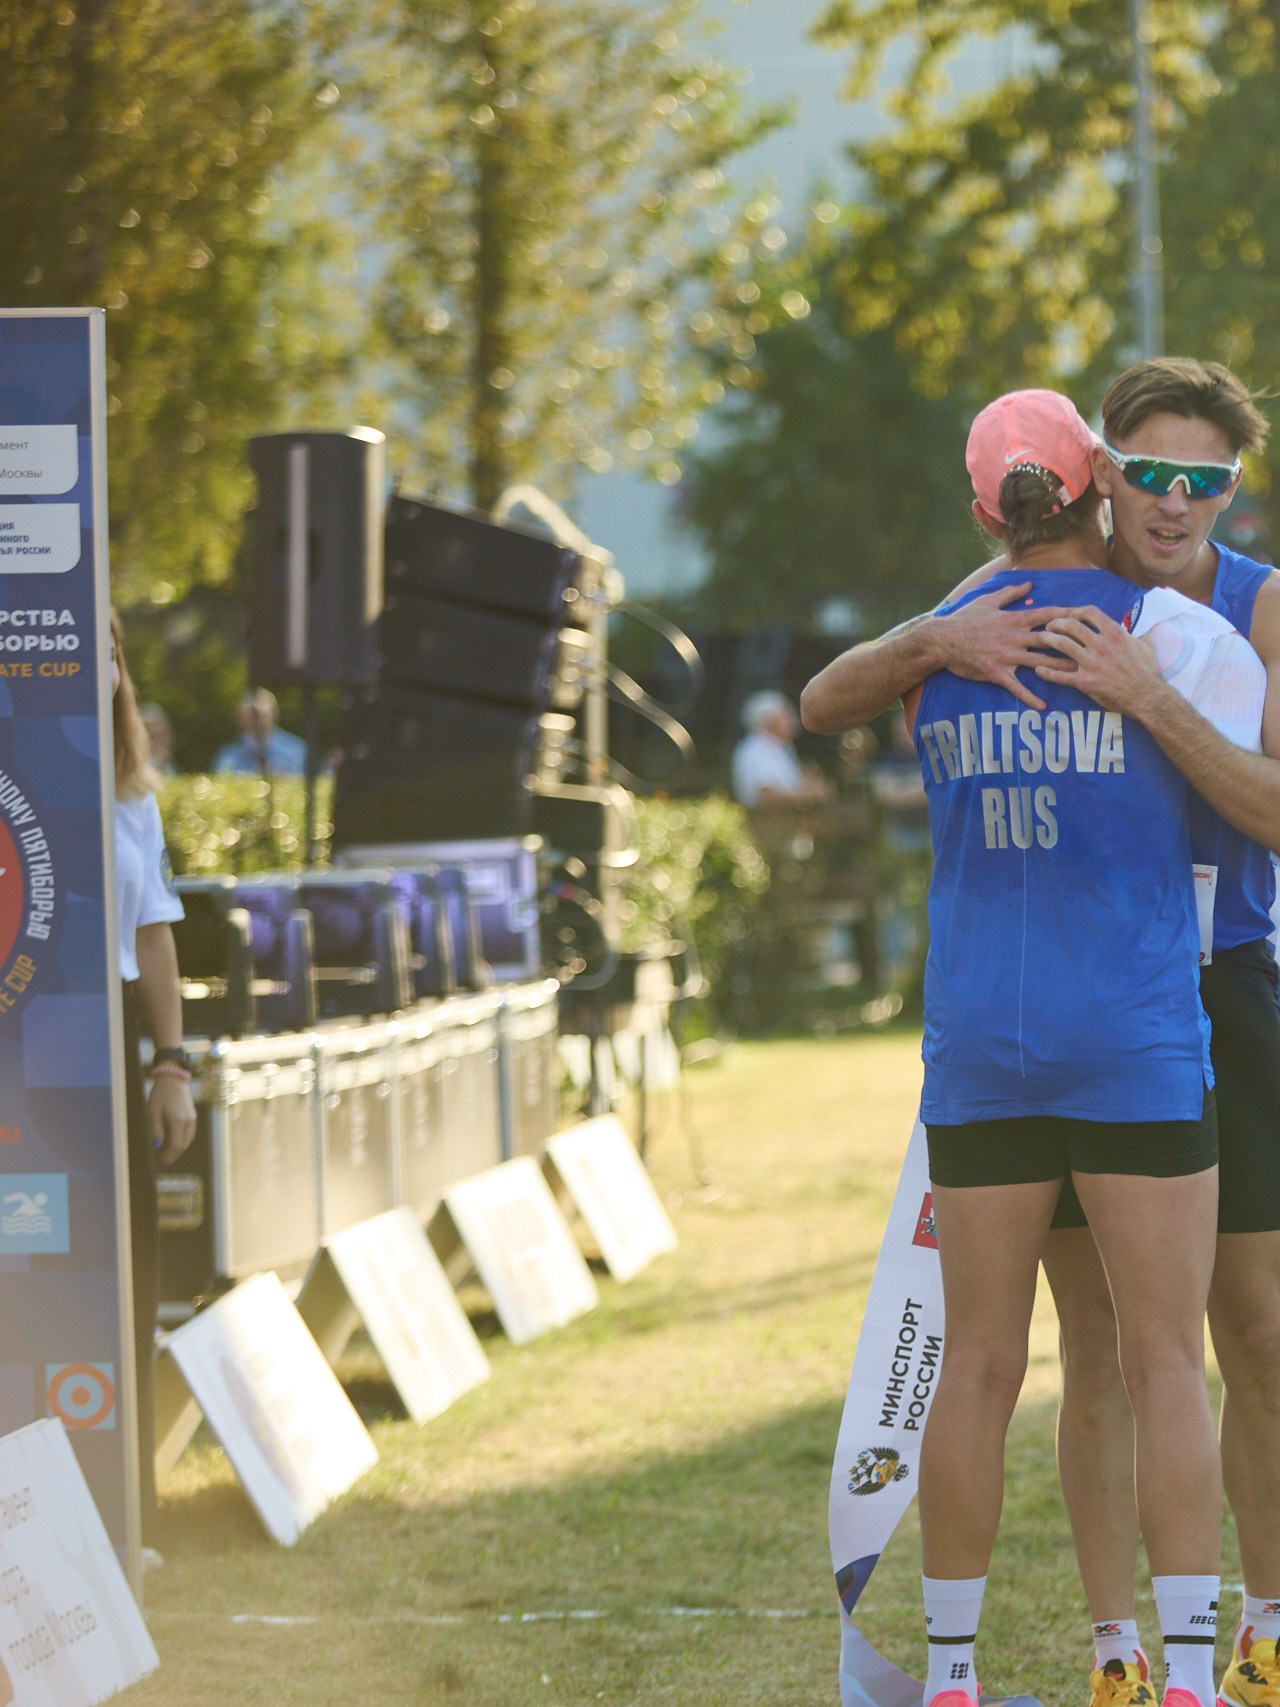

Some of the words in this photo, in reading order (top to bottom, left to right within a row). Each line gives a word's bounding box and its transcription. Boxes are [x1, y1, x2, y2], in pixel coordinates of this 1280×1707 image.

[38, 661, 81, 677] CUP
[919, 710, 1125, 784] FRALTSOVA
[981, 785, 1059, 850] RUS
[20, 826, 54, 940] ПЯТИБОРЬЮ
[878, 1297, 923, 1428] МИНСПОРТ
[903, 1335, 943, 1431] РОССИИ
